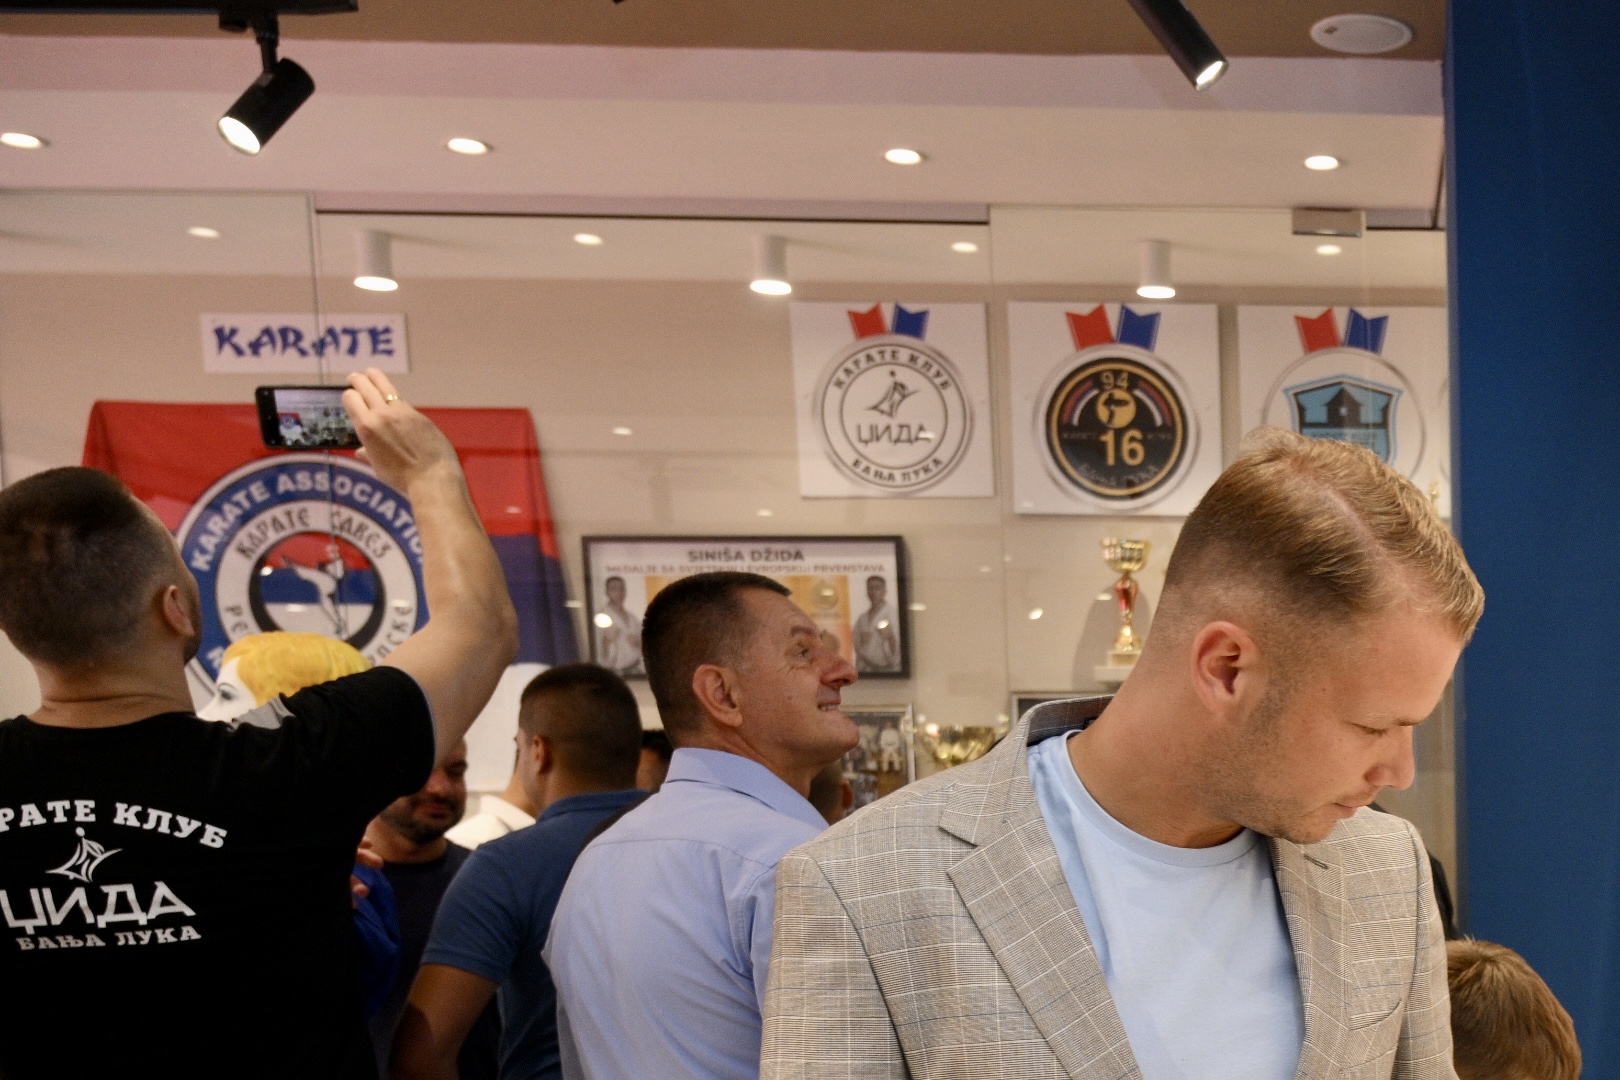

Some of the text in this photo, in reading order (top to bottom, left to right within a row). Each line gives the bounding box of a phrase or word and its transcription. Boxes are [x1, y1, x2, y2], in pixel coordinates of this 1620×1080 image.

[213, 325, 395, 358] KARATE
[833, 349, 952, 391] КАРАТЕ КЛУБ
[1100, 371, 1129, 390] 94
[1100, 428, 1146, 466] 16
[190, 480, 271, 573] KARATE
[687, 547, 806, 563] SINIŠA DŽIDA
[0, 799, 228, 849] РАТЕ КЛУБ
[15, 925, 202, 950] БАЊА ЛУКА
